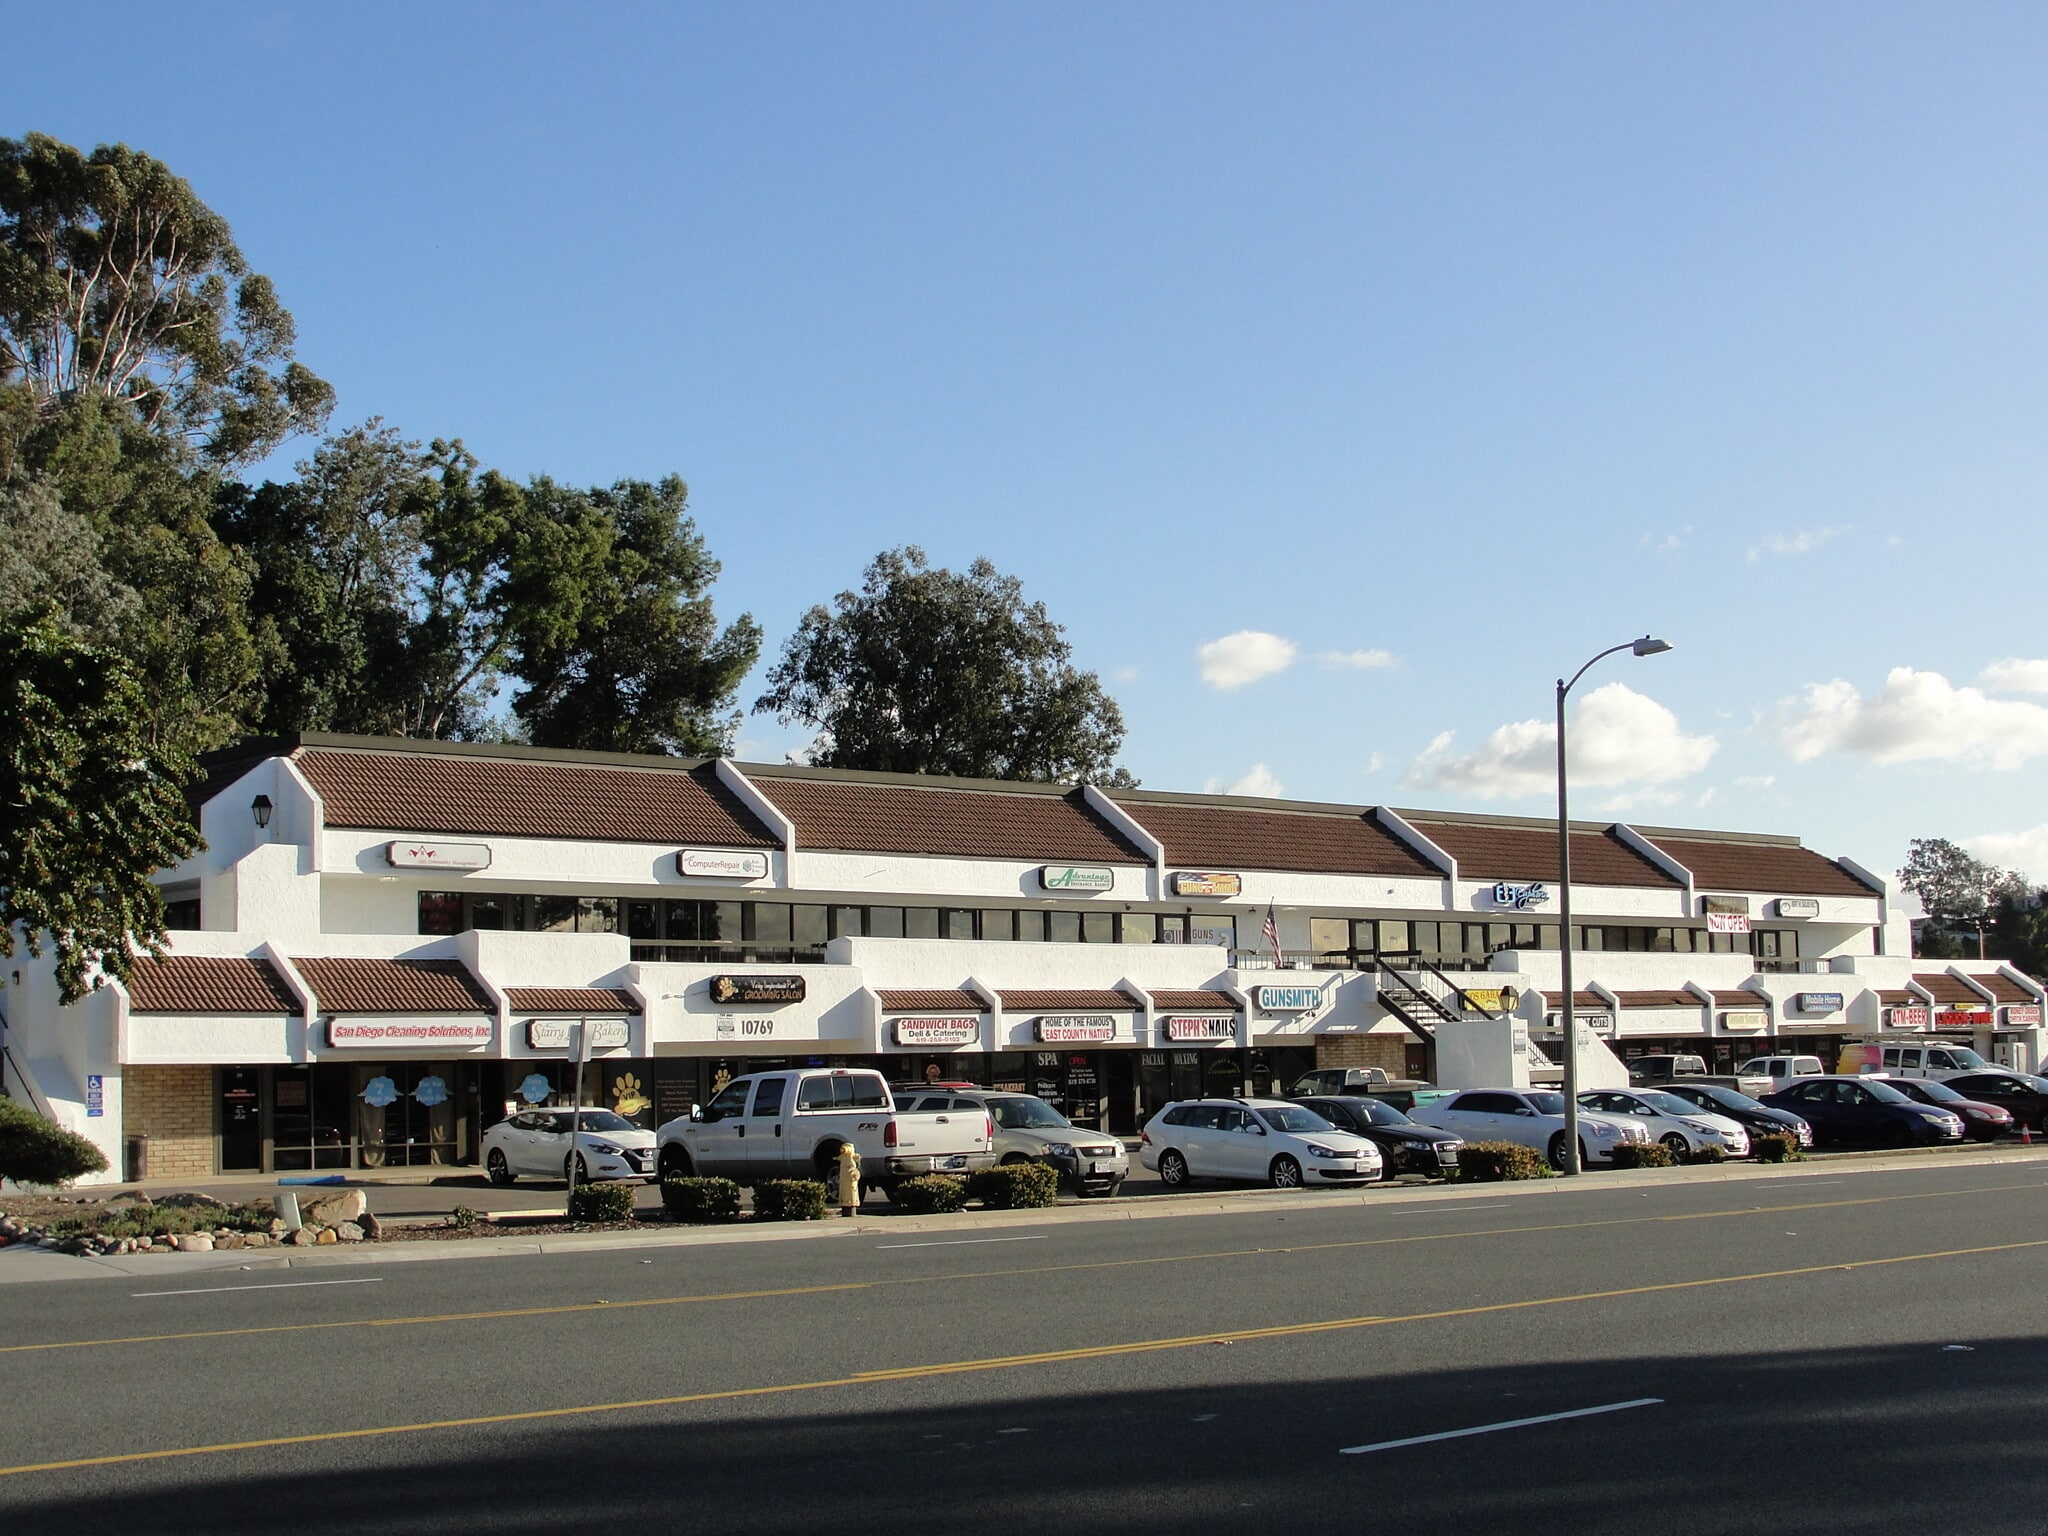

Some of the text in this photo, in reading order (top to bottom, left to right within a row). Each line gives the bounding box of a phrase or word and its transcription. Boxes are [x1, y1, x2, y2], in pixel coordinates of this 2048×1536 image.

[1048, 868, 1110, 887] Advantage
[1709, 914, 1751, 931] NOW OPEN
[1192, 928, 1214, 939] GUNS
[744, 990, 802, 999] GROOMING SALON
[1262, 988, 1319, 1006] GUNSMITH
[1806, 994, 1840, 1004] Mobile Home
[741, 1020, 774, 1035] 10769
[901, 1019, 974, 1030] SANDWICH BAGS
[1045, 1018, 1110, 1026] HOME OF THE FAMOUS
[1171, 1018, 1235, 1036] STEPH'S NAILS
[1592, 1018, 1608, 1026] CUTS
[335, 1025, 489, 1038] San Diego Cleaning Solutions, Inc
[532, 1024, 564, 1040] Starry
[592, 1023, 627, 1041] Bakery
[933, 1030, 967, 1038] Catering
[1062, 1029, 1087, 1039] COUNTY
[1037, 1052, 1058, 1066] SPA
[1141, 1052, 1198, 1065] FACIAL WAXING
[622, 1091, 636, 1100] VIP
